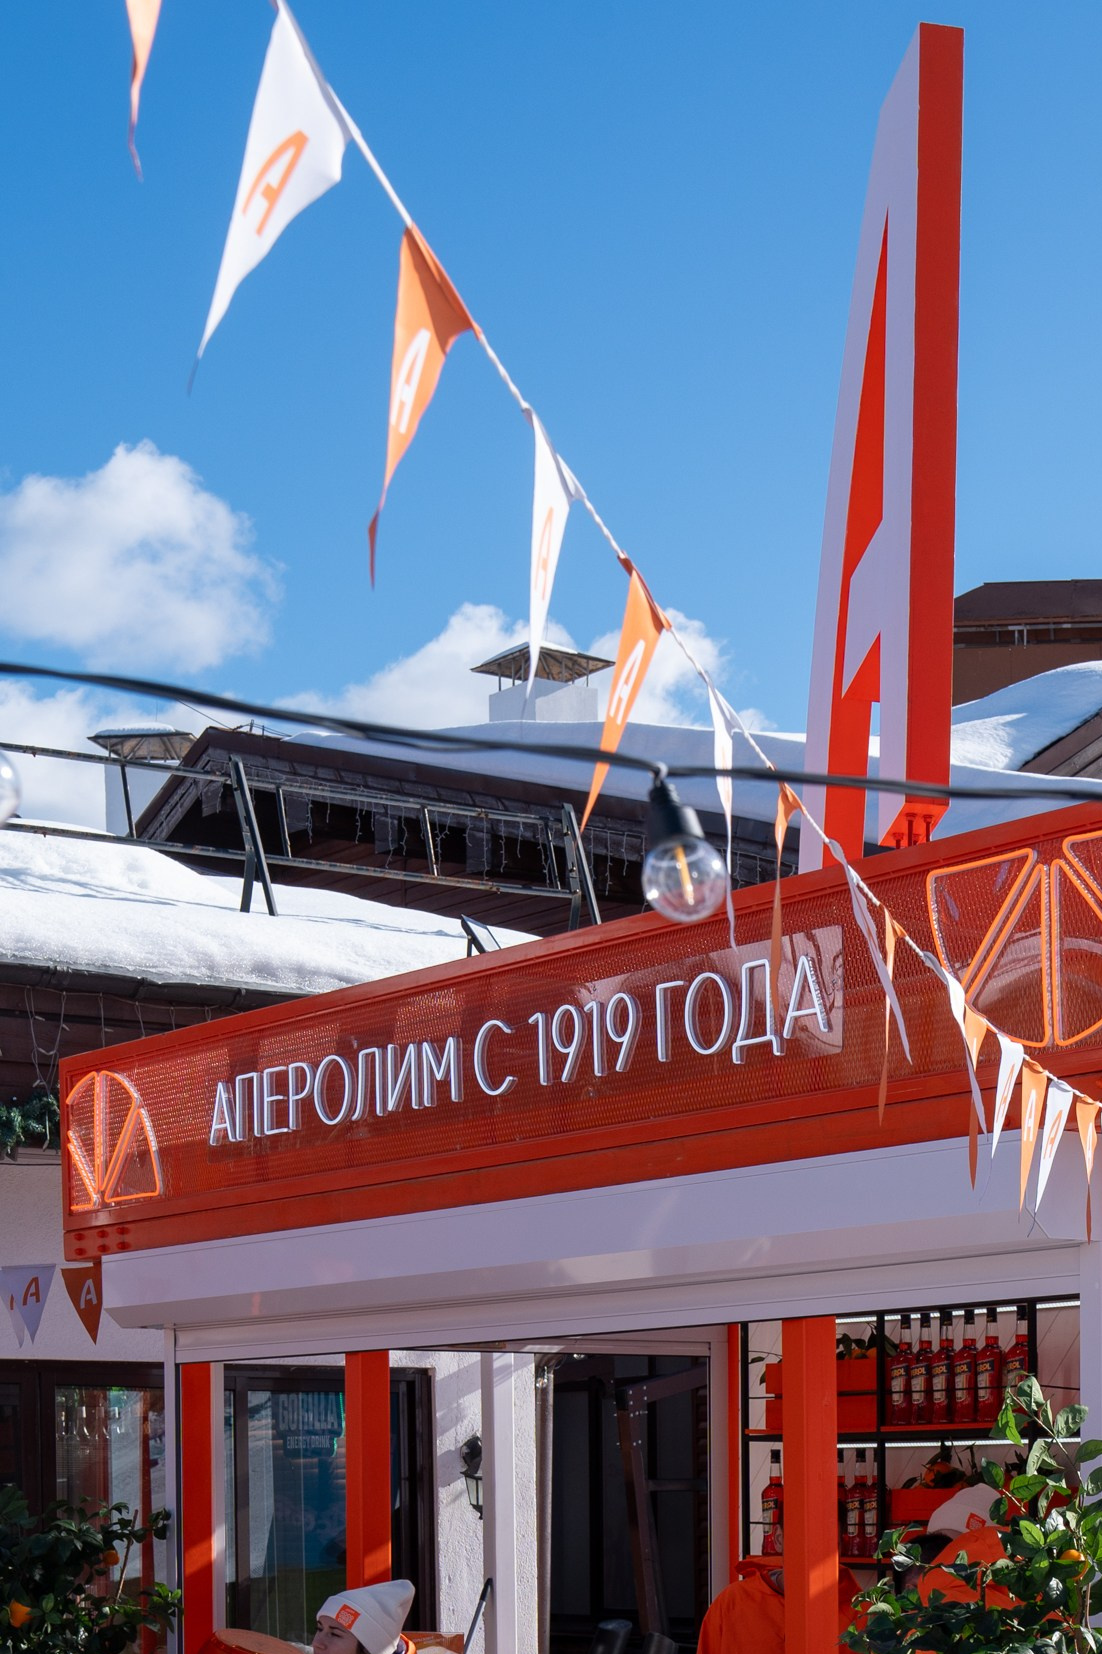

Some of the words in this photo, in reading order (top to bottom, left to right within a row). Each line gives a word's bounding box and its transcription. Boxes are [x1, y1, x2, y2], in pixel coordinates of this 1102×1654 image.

[242, 129, 309, 238] A
[389, 327, 431, 435] A
[534, 506, 553, 601] A
[609, 639, 646, 726] A
[209, 1036, 464, 1146] АПЕРОЛИМ
[474, 1018, 517, 1096] С
[528, 992, 642, 1086] 1919
[655, 954, 832, 1065] ГОДА
[1023, 1088, 1037, 1142] A
[1042, 1108, 1063, 1160] A
[22, 1275, 41, 1307] A
[80, 1278, 98, 1310] A
[278, 1391, 338, 1431] GORILLA
[286, 1435, 310, 1449] ENERGY
[311, 1434, 331, 1448] DRINK
